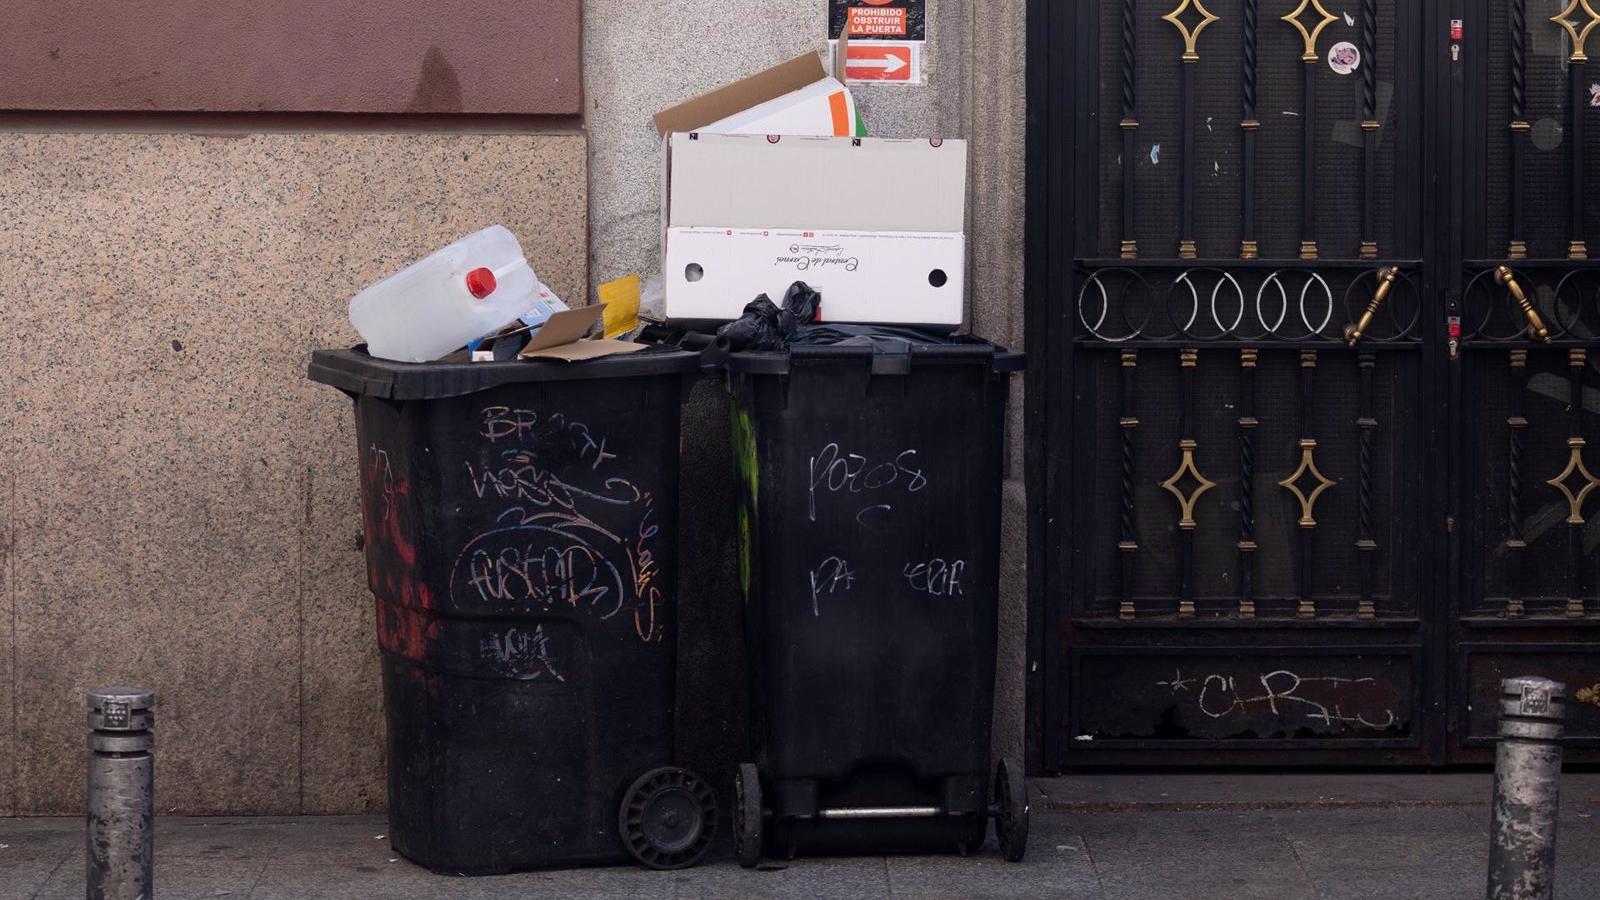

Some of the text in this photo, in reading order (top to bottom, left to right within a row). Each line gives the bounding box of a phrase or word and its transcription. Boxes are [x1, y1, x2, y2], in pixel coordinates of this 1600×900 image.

[851, 8, 903, 16] PROHIBIDO
[853, 16, 901, 24] OBSTRUIR
[851, 25, 903, 33] LA PUERTA
[774, 255, 859, 272] Central de Carnes
